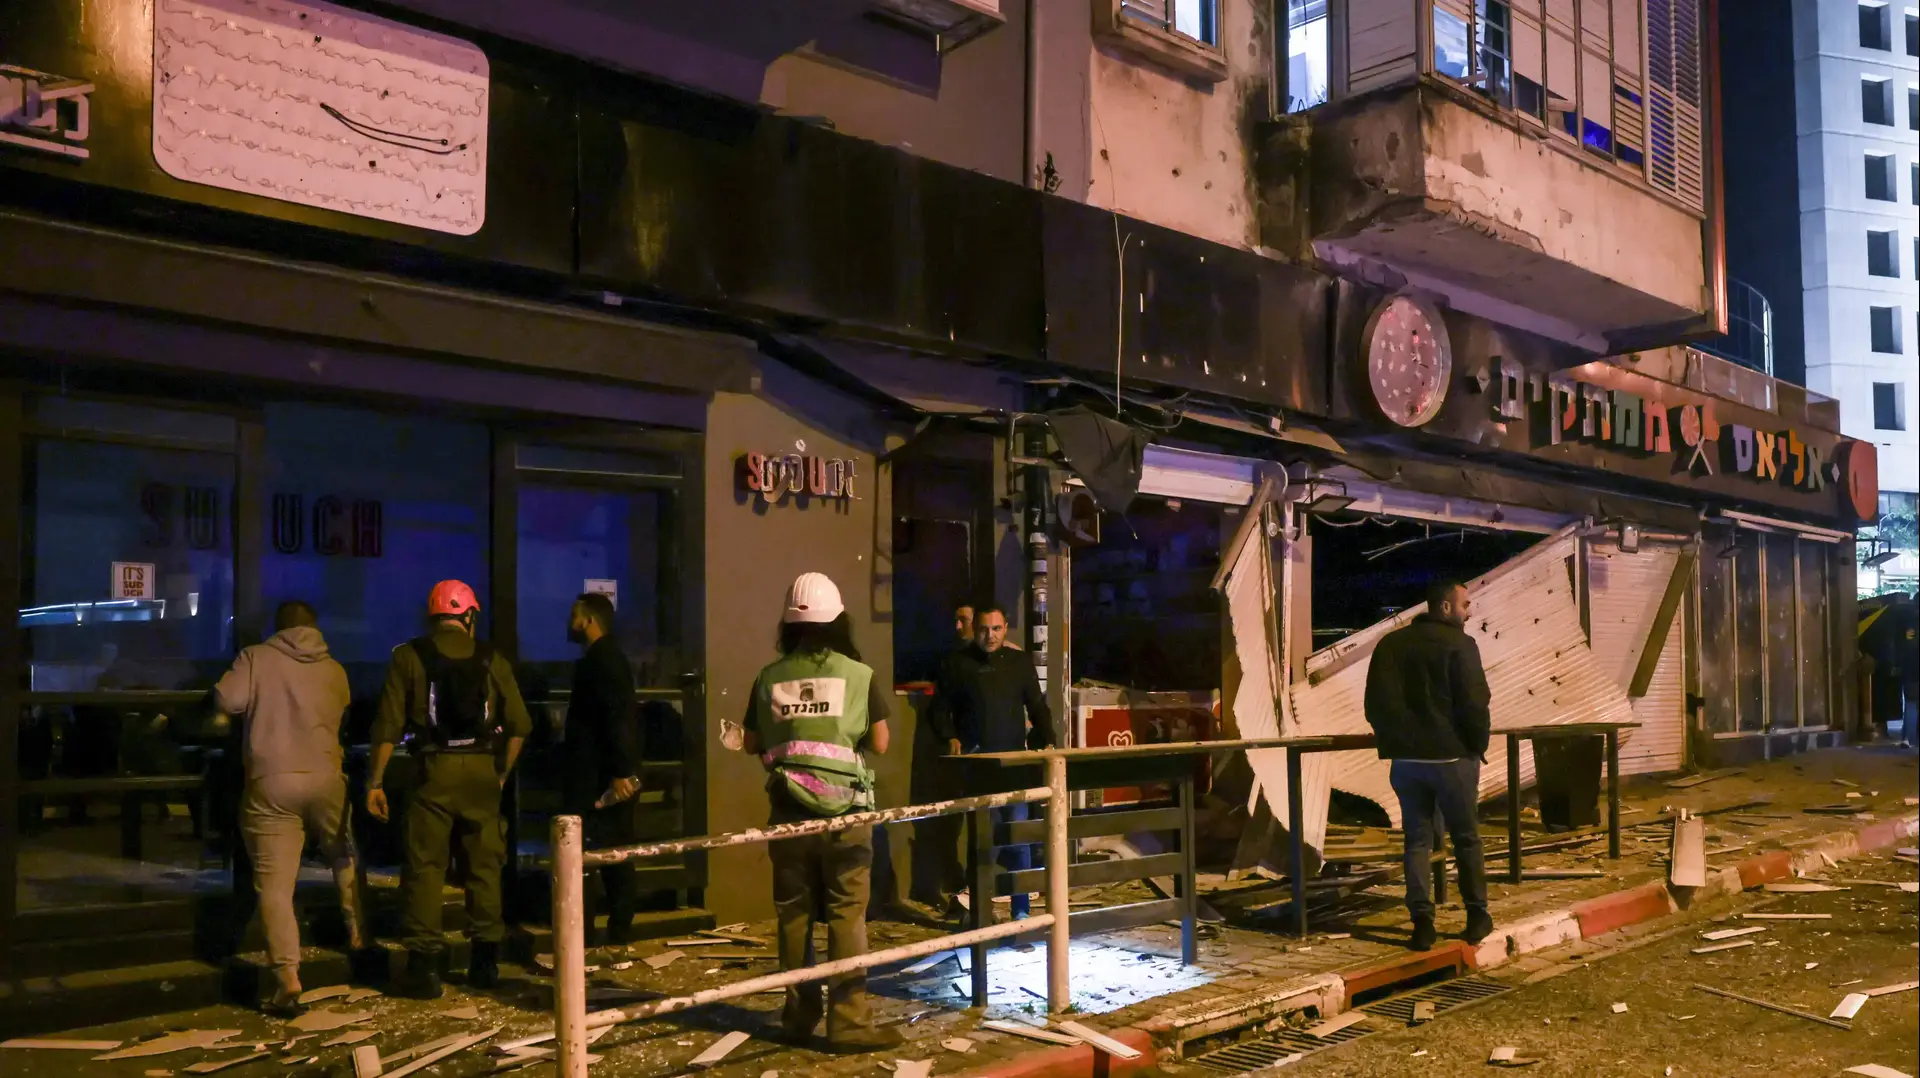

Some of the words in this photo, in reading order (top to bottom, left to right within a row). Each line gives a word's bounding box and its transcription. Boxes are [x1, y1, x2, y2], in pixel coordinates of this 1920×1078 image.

[1500, 354, 1672, 453] ממתקים
[1732, 423, 1825, 493] אליאס
[781, 701, 830, 716] מהנדס
